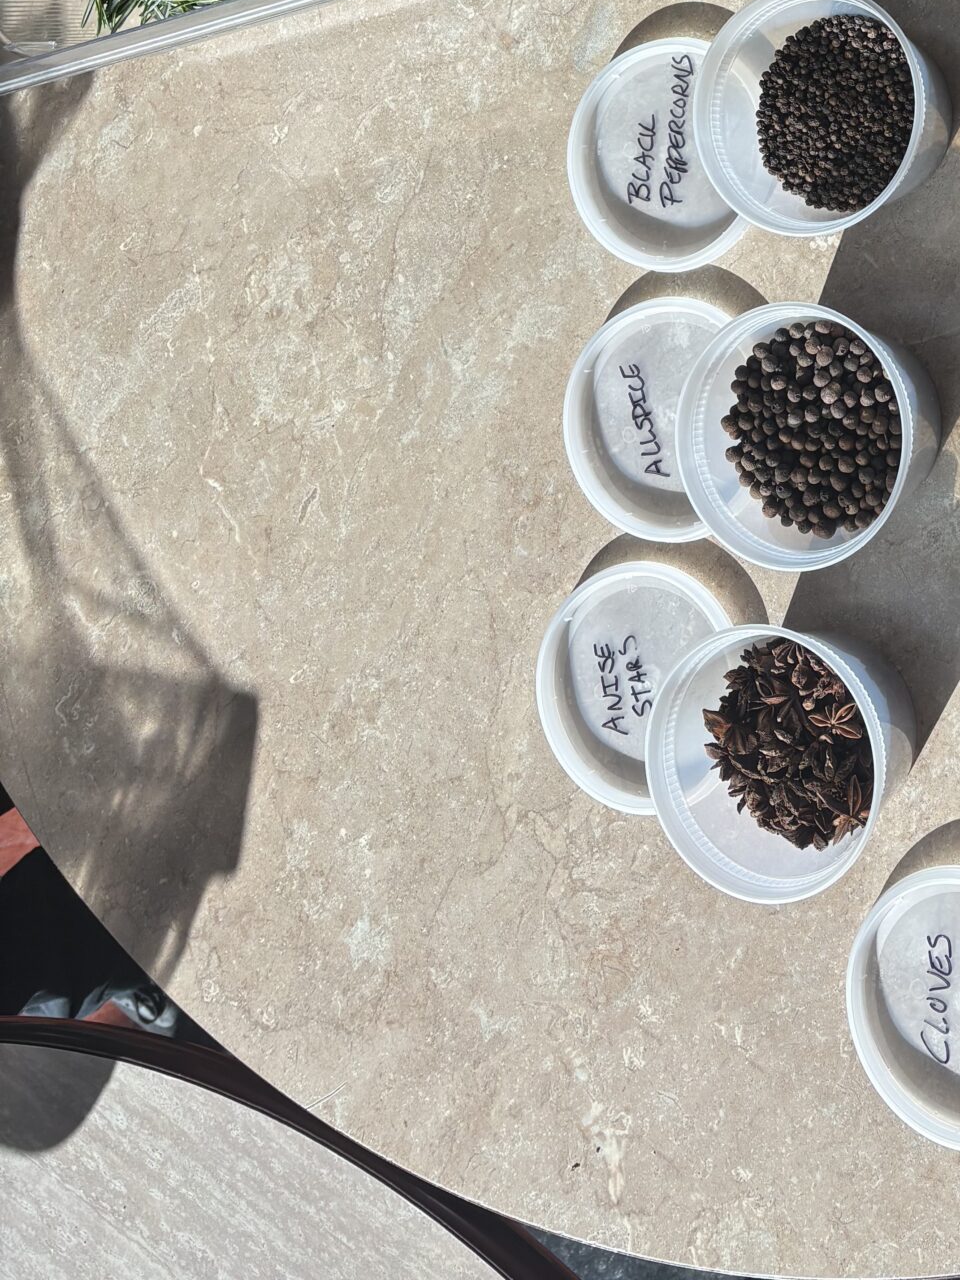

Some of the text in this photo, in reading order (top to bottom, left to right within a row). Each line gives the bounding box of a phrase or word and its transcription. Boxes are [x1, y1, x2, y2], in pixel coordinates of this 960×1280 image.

[627, 114, 657, 205] BLACK
[659, 54, 694, 208] PEPPERCORNS
[619, 363, 671, 478] ALLSPICE
[593, 643, 629, 736] ANISE
[618, 634, 653, 718] STARS
[921, 933, 953, 1065] CLOVES
